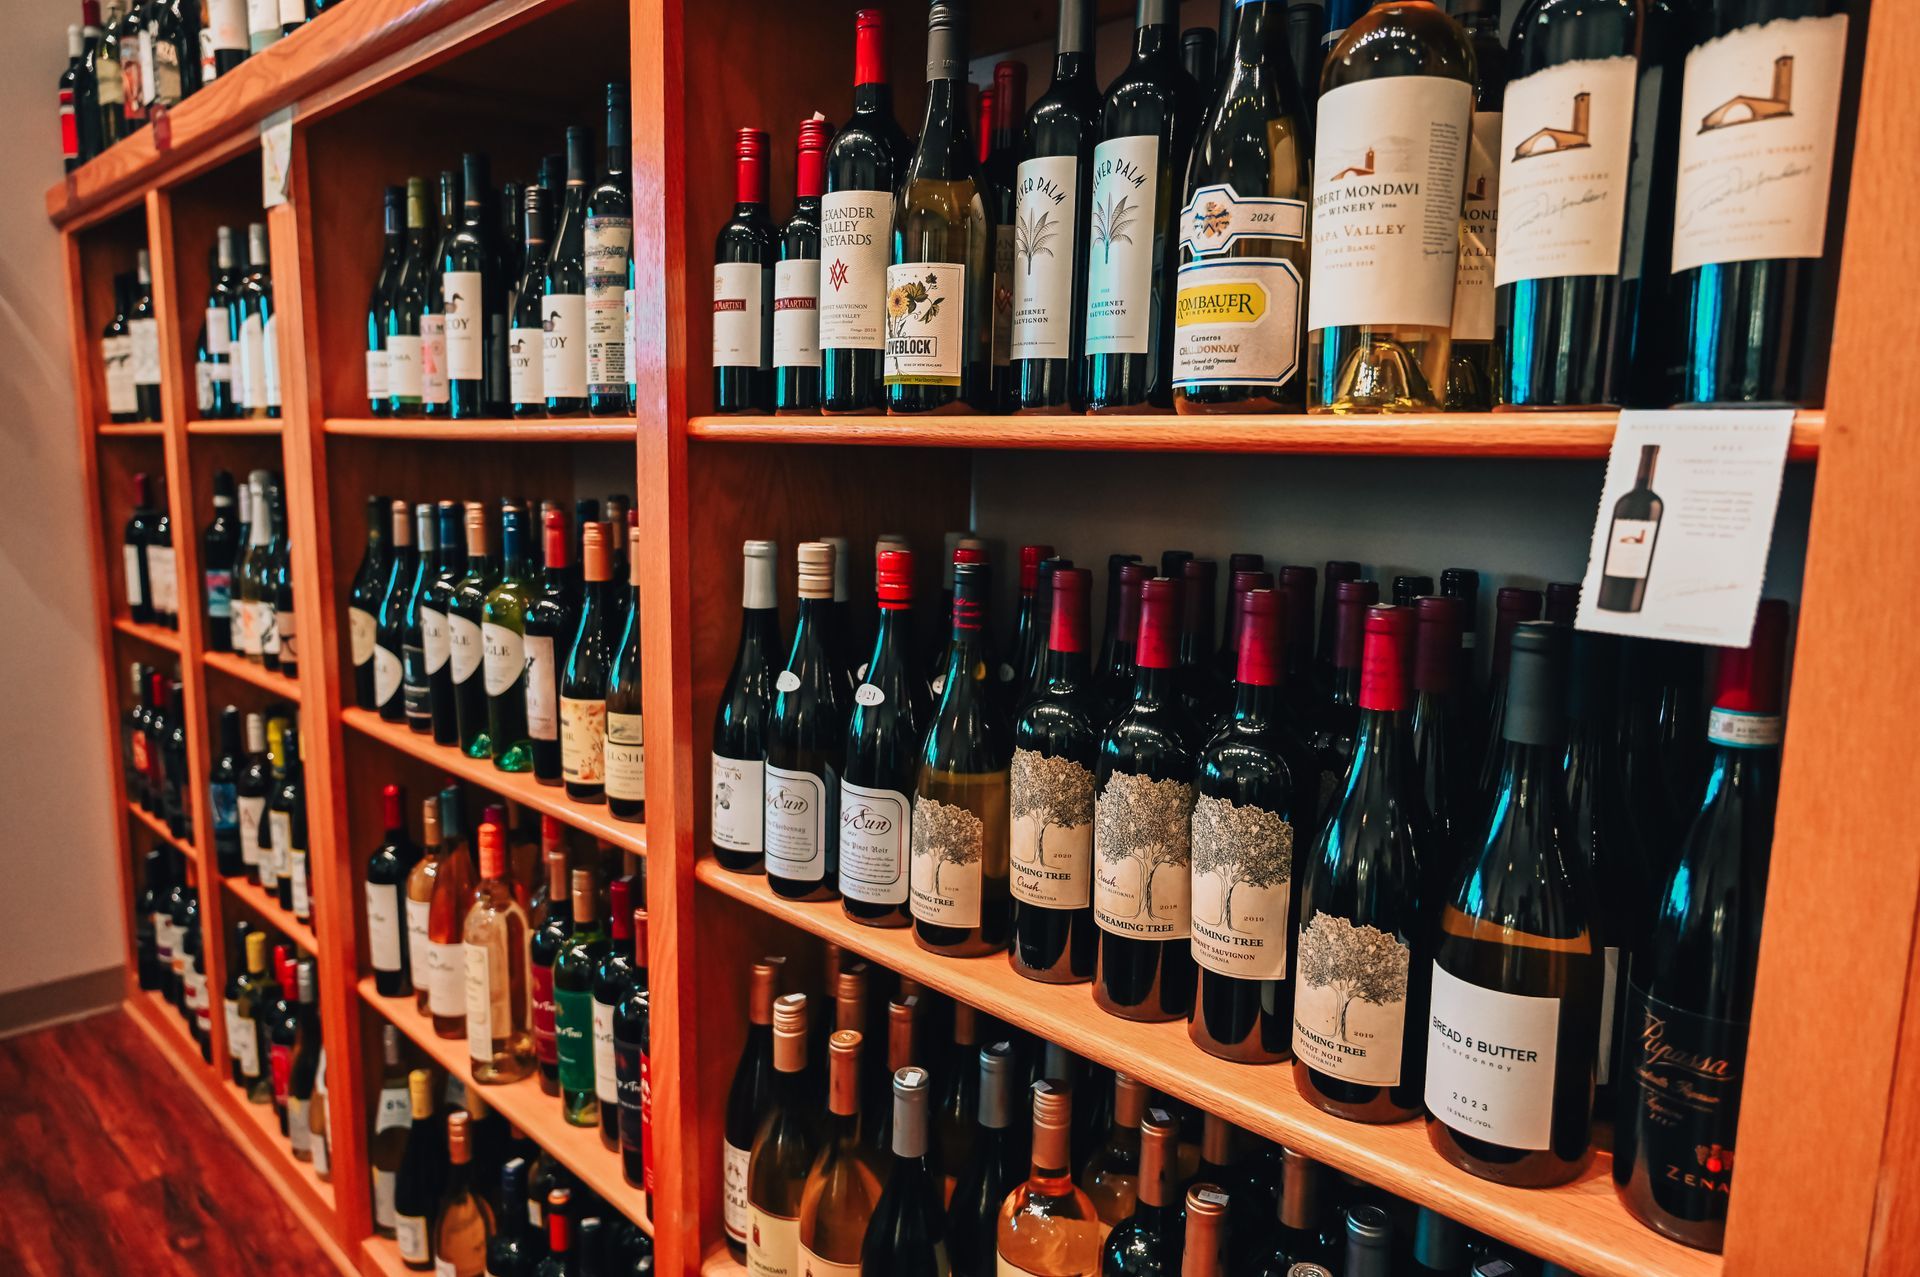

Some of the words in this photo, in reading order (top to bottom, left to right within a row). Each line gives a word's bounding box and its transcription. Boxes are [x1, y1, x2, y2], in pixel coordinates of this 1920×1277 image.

[1116, 158, 1147, 189] PALM
[1037, 177, 1067, 206] PALM
[1345, 183, 1419, 199] MONDAVI
[1329, 202, 1375, 216] WINERY
[1251, 213, 1275, 223] 2024
[825, 220, 859, 233] VALLEY
[1344, 224, 1405, 237] VALLEY
[719, 301, 742, 310] MARTINI
[785, 300, 813, 309] MARTINI
[1092, 300, 1124, 309] CABERNET
[1178, 294, 1255, 319] ROMBAUER
[1186, 307, 1230, 316] VINEYARDS
[1016, 309, 1046, 317] CABERNET
[1090, 309, 1127, 318] SAUVIGNON
[774, 789, 804, 811] Sun
[853, 808, 887, 831] Sun
[852, 842, 869, 852] Pinot
[871, 845, 889, 854] Noir
[1044, 872, 1072, 880] TREE
[1097, 869, 1118, 888] Crush
[1017, 876, 1041, 892] Crush
[1028, 893, 1057, 901] ARGENTINA
[1105, 887, 1135, 899] CALIFORNIA
[933, 898, 954, 907] TREE
[1098, 912, 1144, 932] DREAMING
[1146, 923, 1174, 932] TREE
[1232, 936, 1264, 947] TREE
[1200, 949, 1229, 964] CALIFORNIA
[1212, 946, 1256, 961] SAUVIGNON
[1354, 1031, 1374, 1039] 2019
[1433, 1016, 1461, 1043] BREAD
[1465, 1037, 1473, 1048] &
[1478, 1041, 1537, 1063] BUTTER
[1300, 1037, 1318, 1054] PINOT
[1321, 1051, 1342, 1063] NOIR
[1337, 1043, 1366, 1057] TREE
[1303, 1048, 1336, 1068] CALIFORNIA
[1453, 1091, 1488, 1112] 2023
